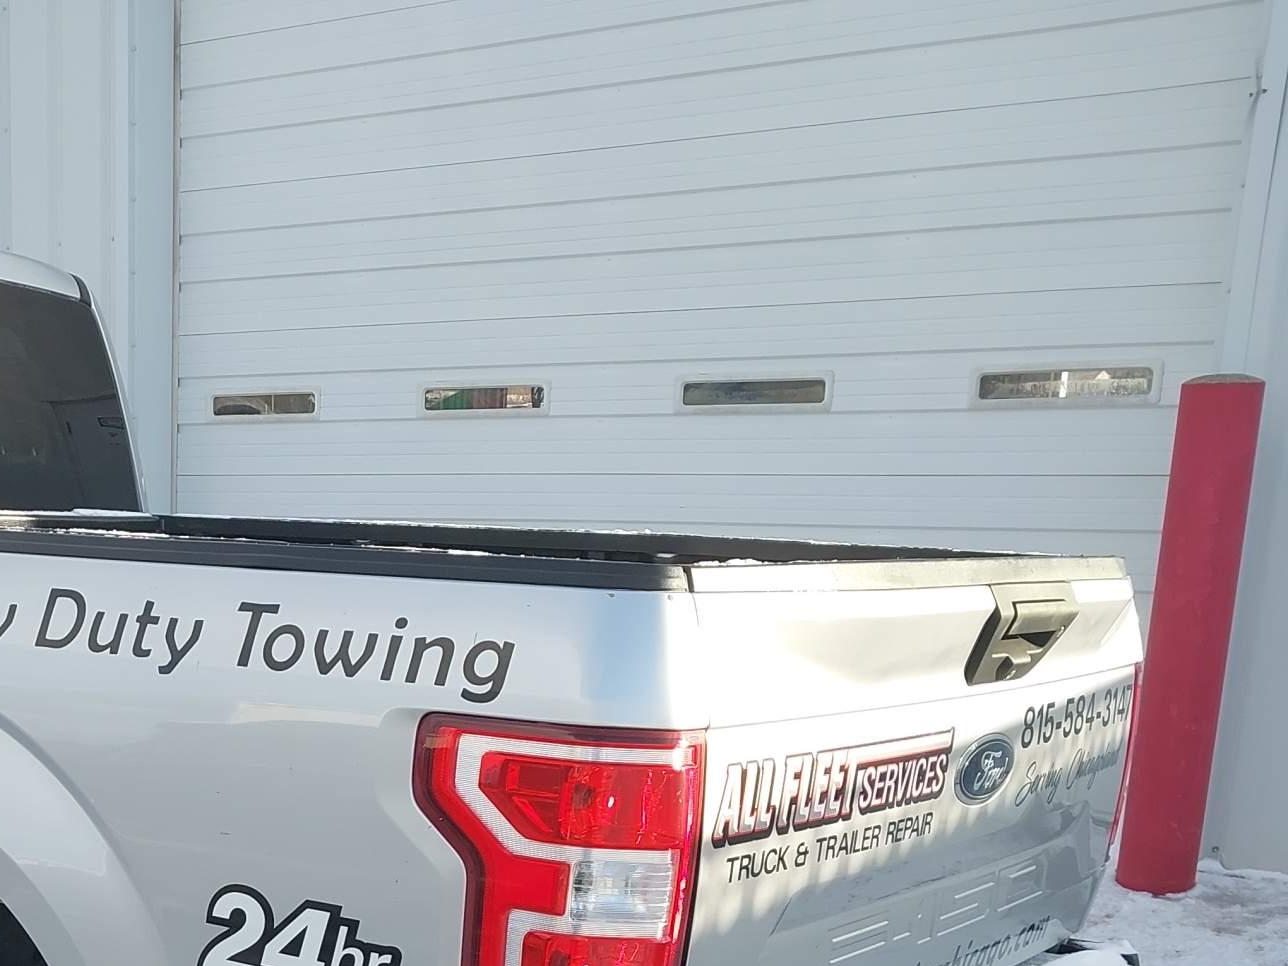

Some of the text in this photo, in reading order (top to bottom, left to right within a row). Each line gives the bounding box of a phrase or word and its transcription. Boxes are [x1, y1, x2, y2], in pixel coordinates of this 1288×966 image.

[33, 587, 204, 675] Duty
[236, 601, 516, 704] Towing
[1020, 684, 1132, 749] 815-584-3147
[712, 750, 858, 848] ALL FLEET
[859, 753, 949, 814] SERVICES
[726, 811, 934, 883] TRUCK & TRAILER REPAIR
